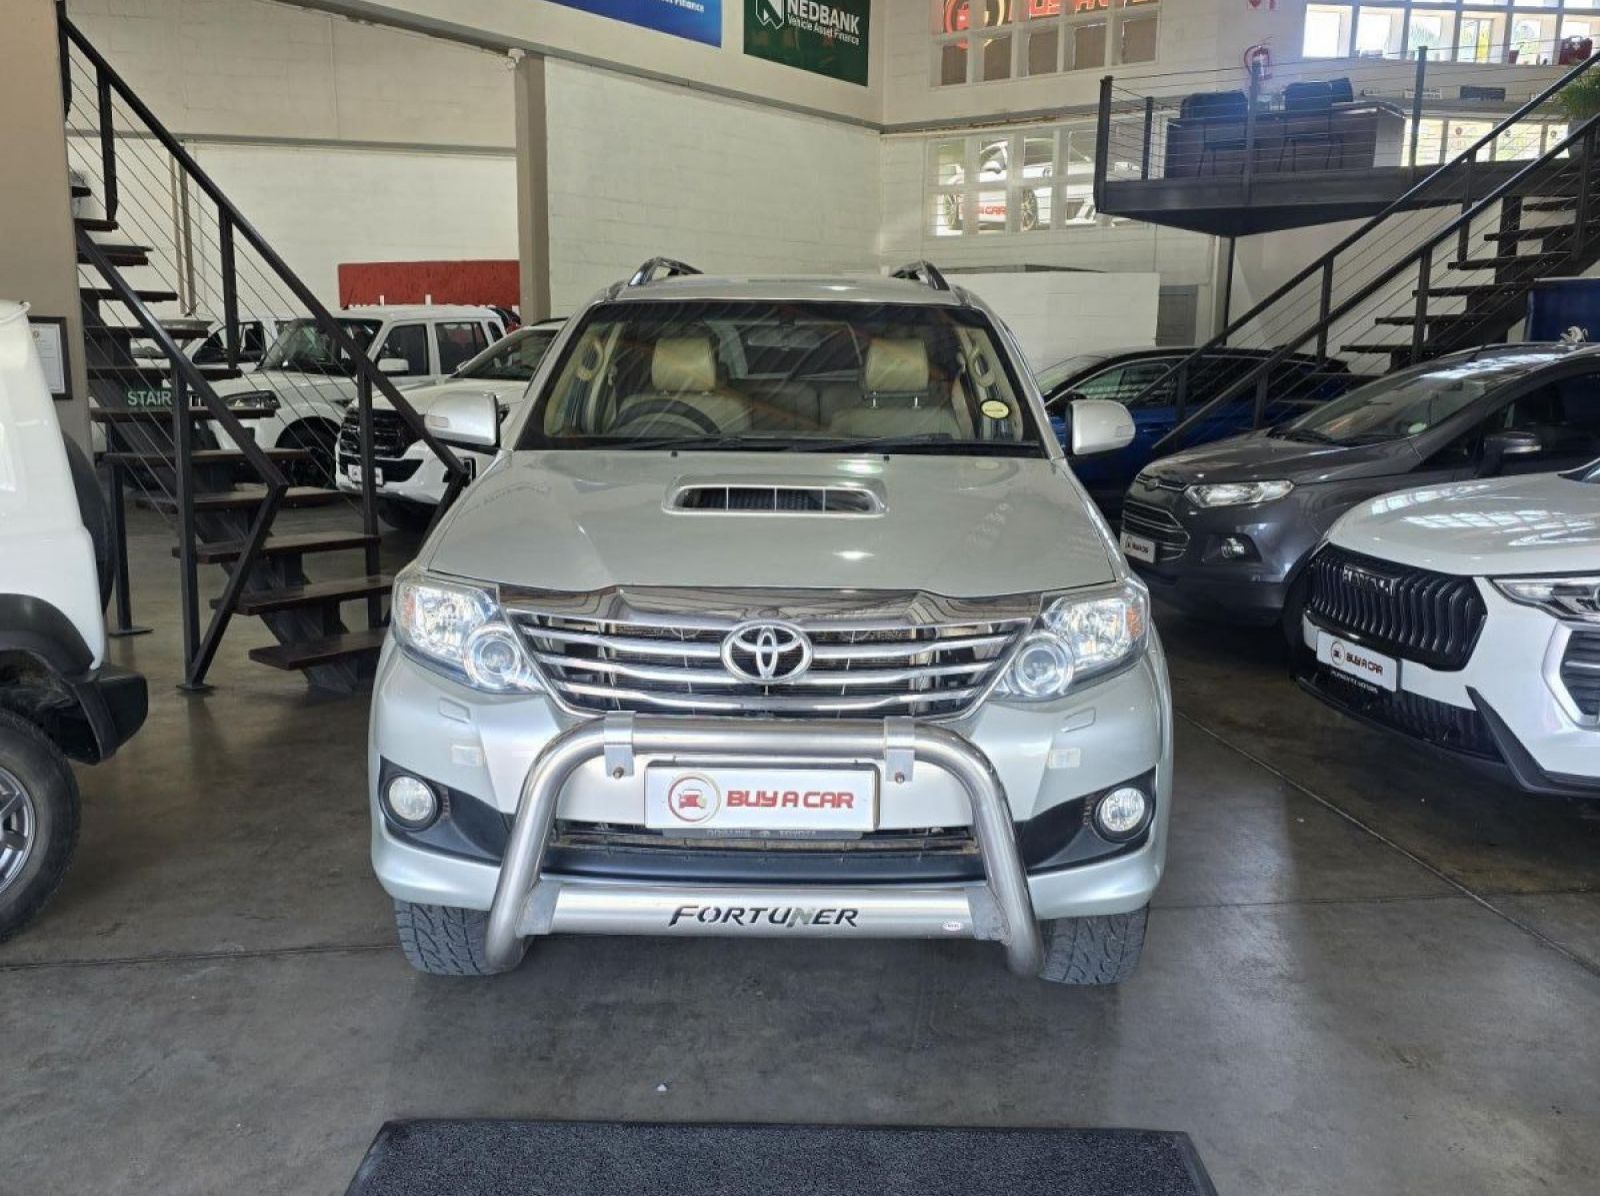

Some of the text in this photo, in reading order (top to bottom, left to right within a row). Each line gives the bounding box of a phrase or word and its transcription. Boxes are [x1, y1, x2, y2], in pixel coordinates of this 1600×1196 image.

[787, 0, 861, 35] NEDBANK
[726, 790, 854, 809] BUY A CAR
[668, 905, 860, 928] FORTUNER
